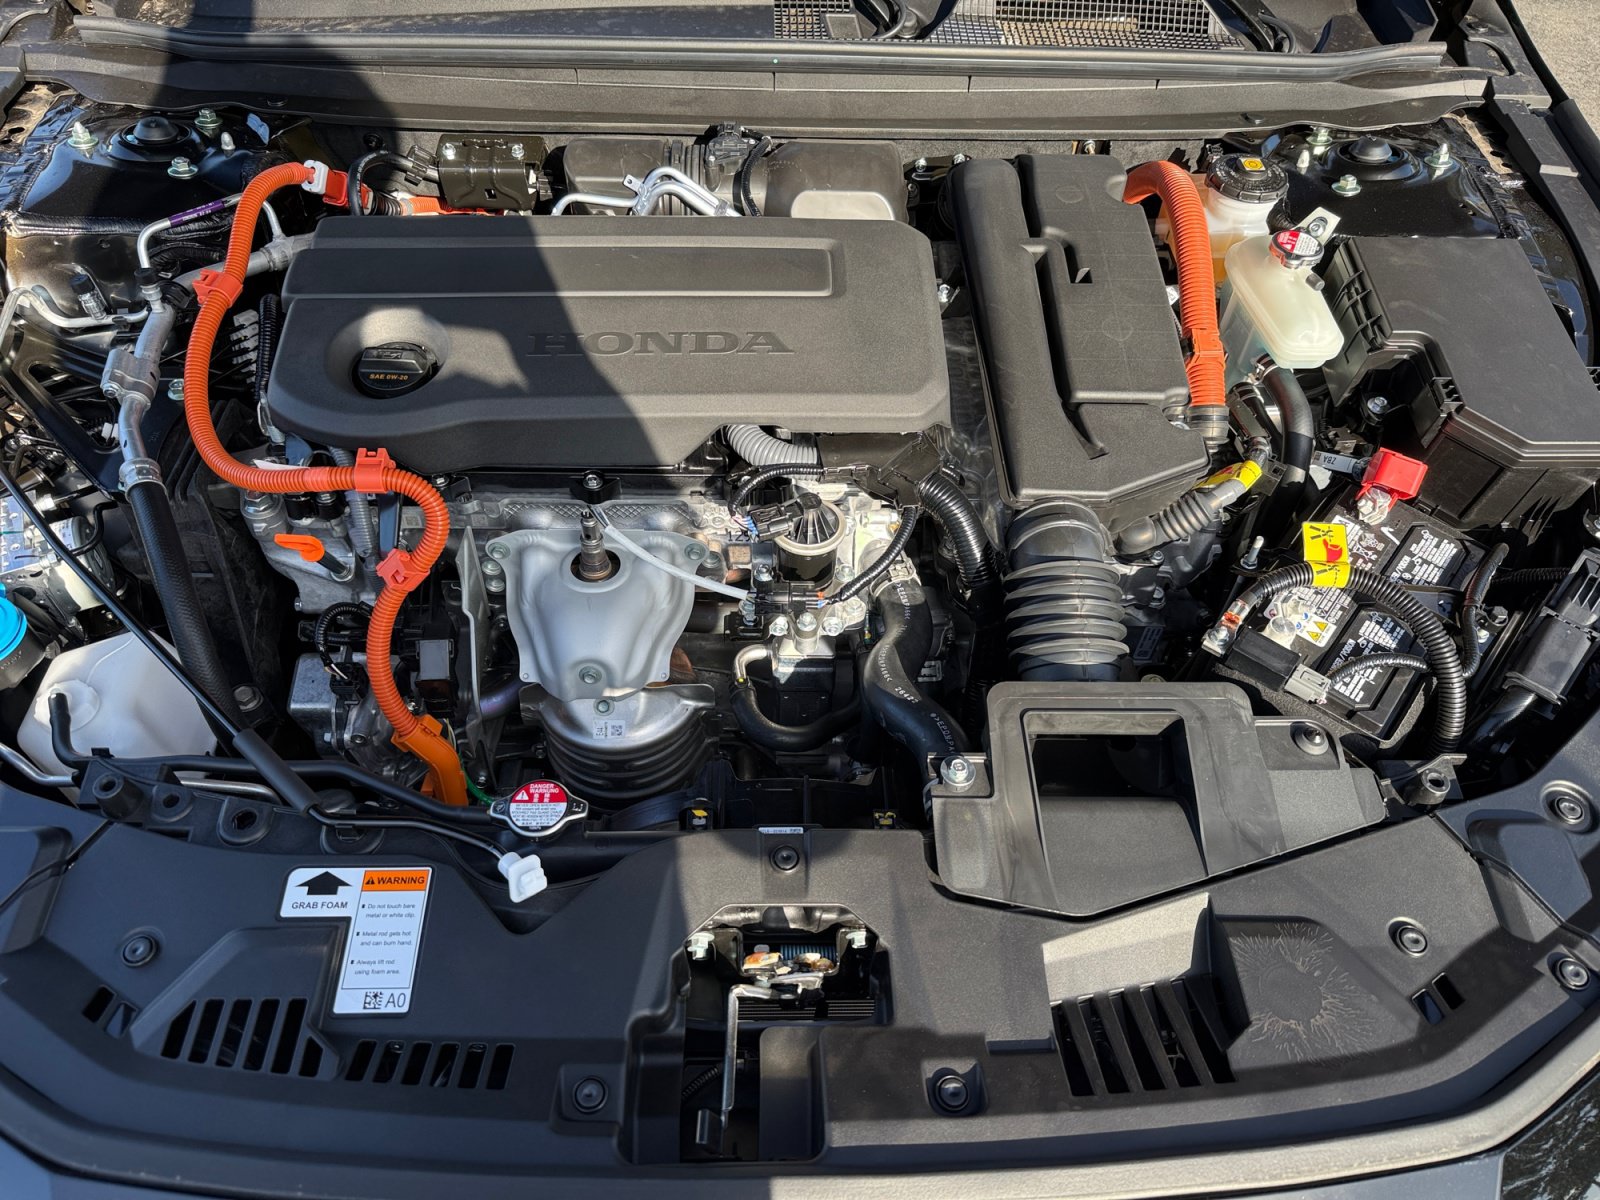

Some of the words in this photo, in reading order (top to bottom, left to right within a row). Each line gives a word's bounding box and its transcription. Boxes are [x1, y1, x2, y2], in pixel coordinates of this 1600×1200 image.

[526, 331, 795, 357] HONDA
[377, 876, 425, 885] WARNING
[291, 901, 318, 910] GRAB
[320, 901, 348, 909] FOAM
[384, 992, 407, 1008] A0
